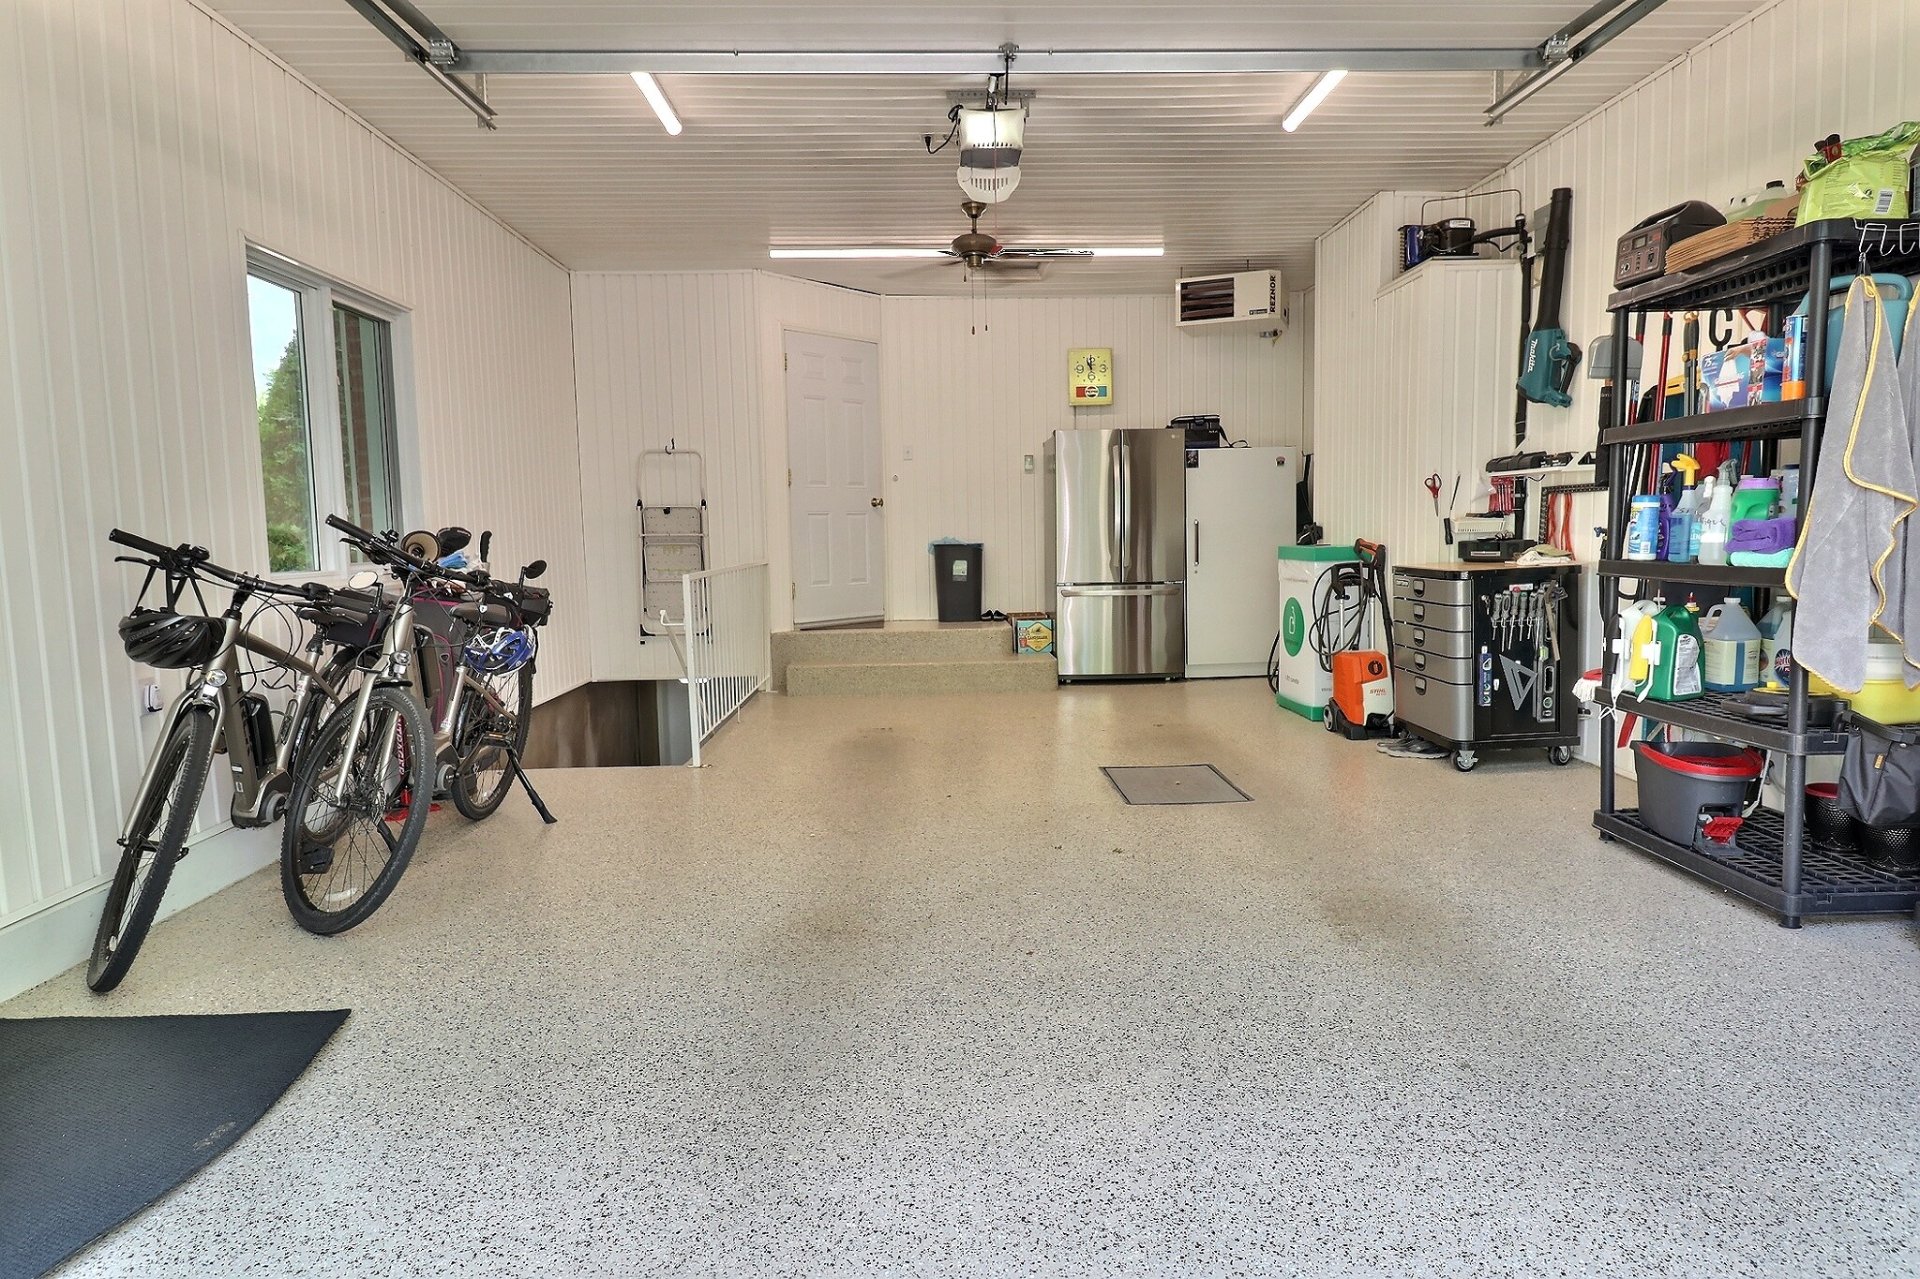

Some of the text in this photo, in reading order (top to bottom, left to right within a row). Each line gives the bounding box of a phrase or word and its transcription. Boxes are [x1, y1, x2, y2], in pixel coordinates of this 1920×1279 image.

[1075, 364, 1085, 374] 9
[1099, 364, 1107, 373] 3
[1087, 371, 1096, 381] 6
